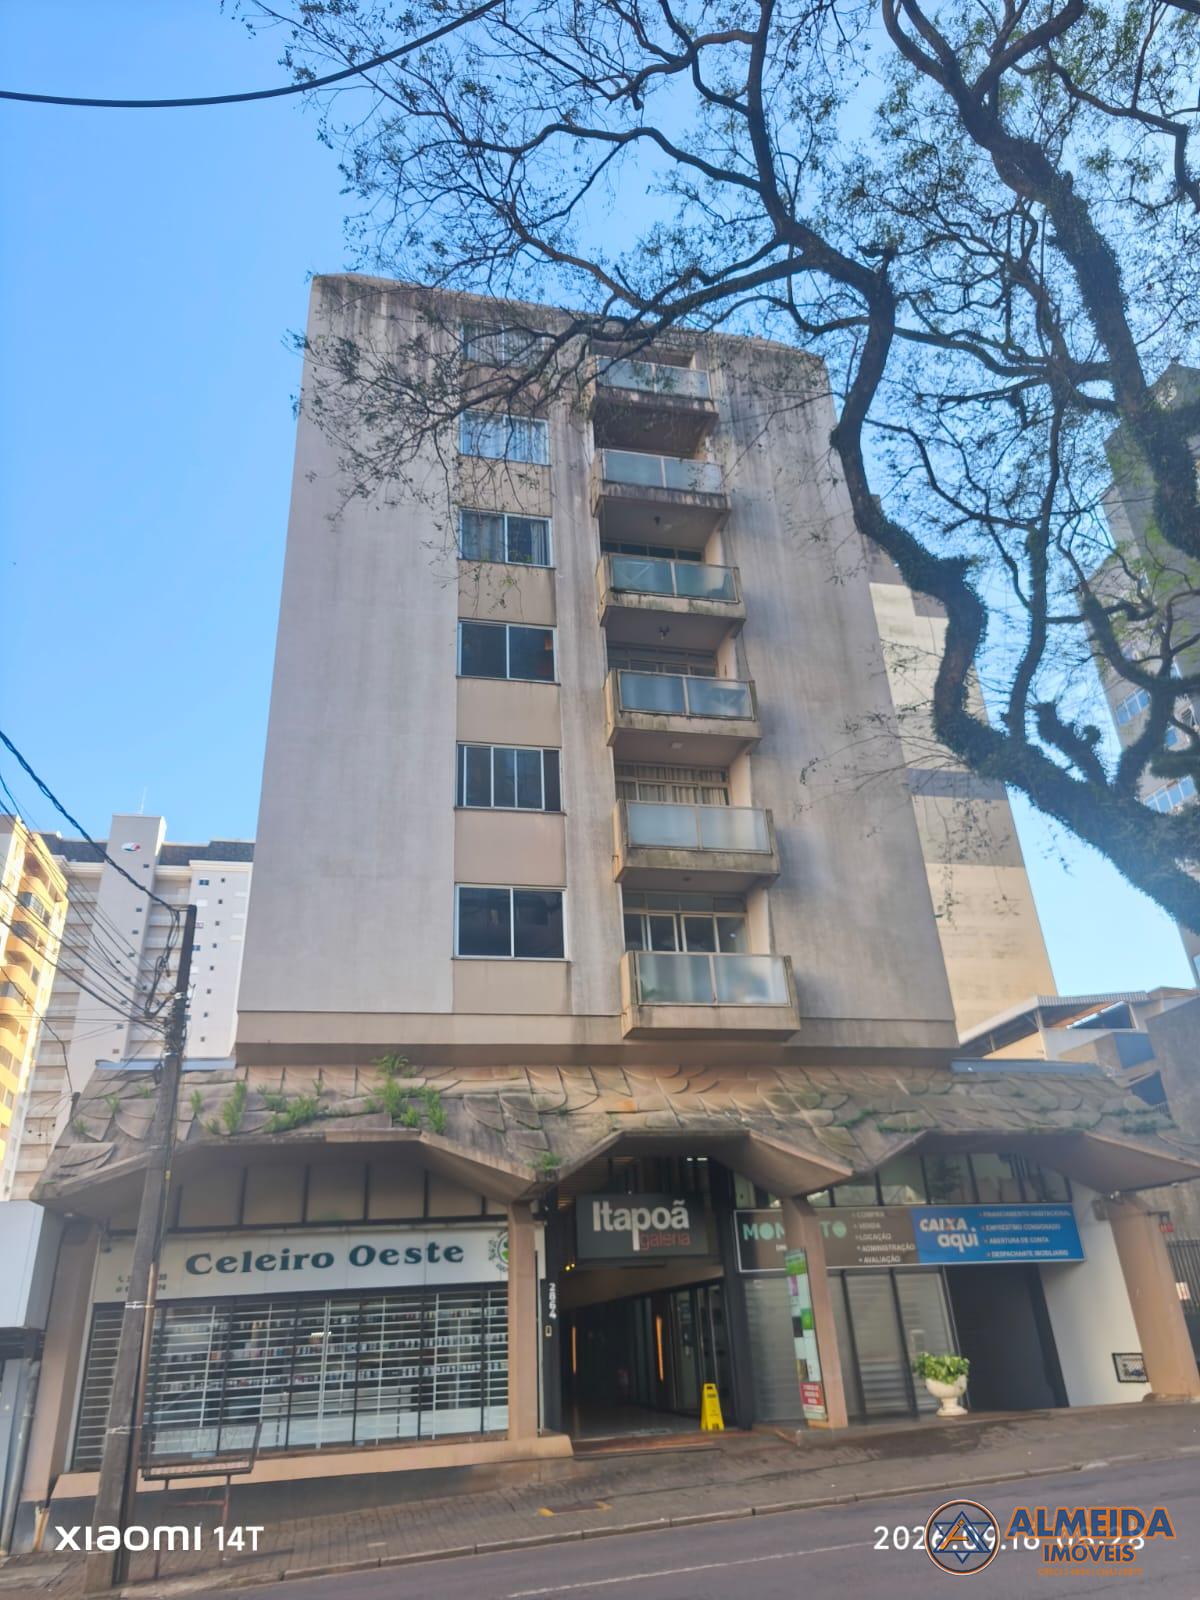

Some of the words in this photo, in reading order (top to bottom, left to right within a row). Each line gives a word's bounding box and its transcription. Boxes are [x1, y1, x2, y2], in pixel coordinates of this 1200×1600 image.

[593, 1200, 690, 1251] Itapoã
[919, 1217, 968, 1233] CAIXA
[640, 1232, 691, 1251] galeria
[859, 1231, 892, 1241] LOCAÇÃO
[937, 1226, 980, 1253] aqui
[185, 1248, 335, 1276] Celeiro
[349, 1241, 465, 1267] Oeste
[863, 1254, 901, 1264] AVALIAÇÃO
